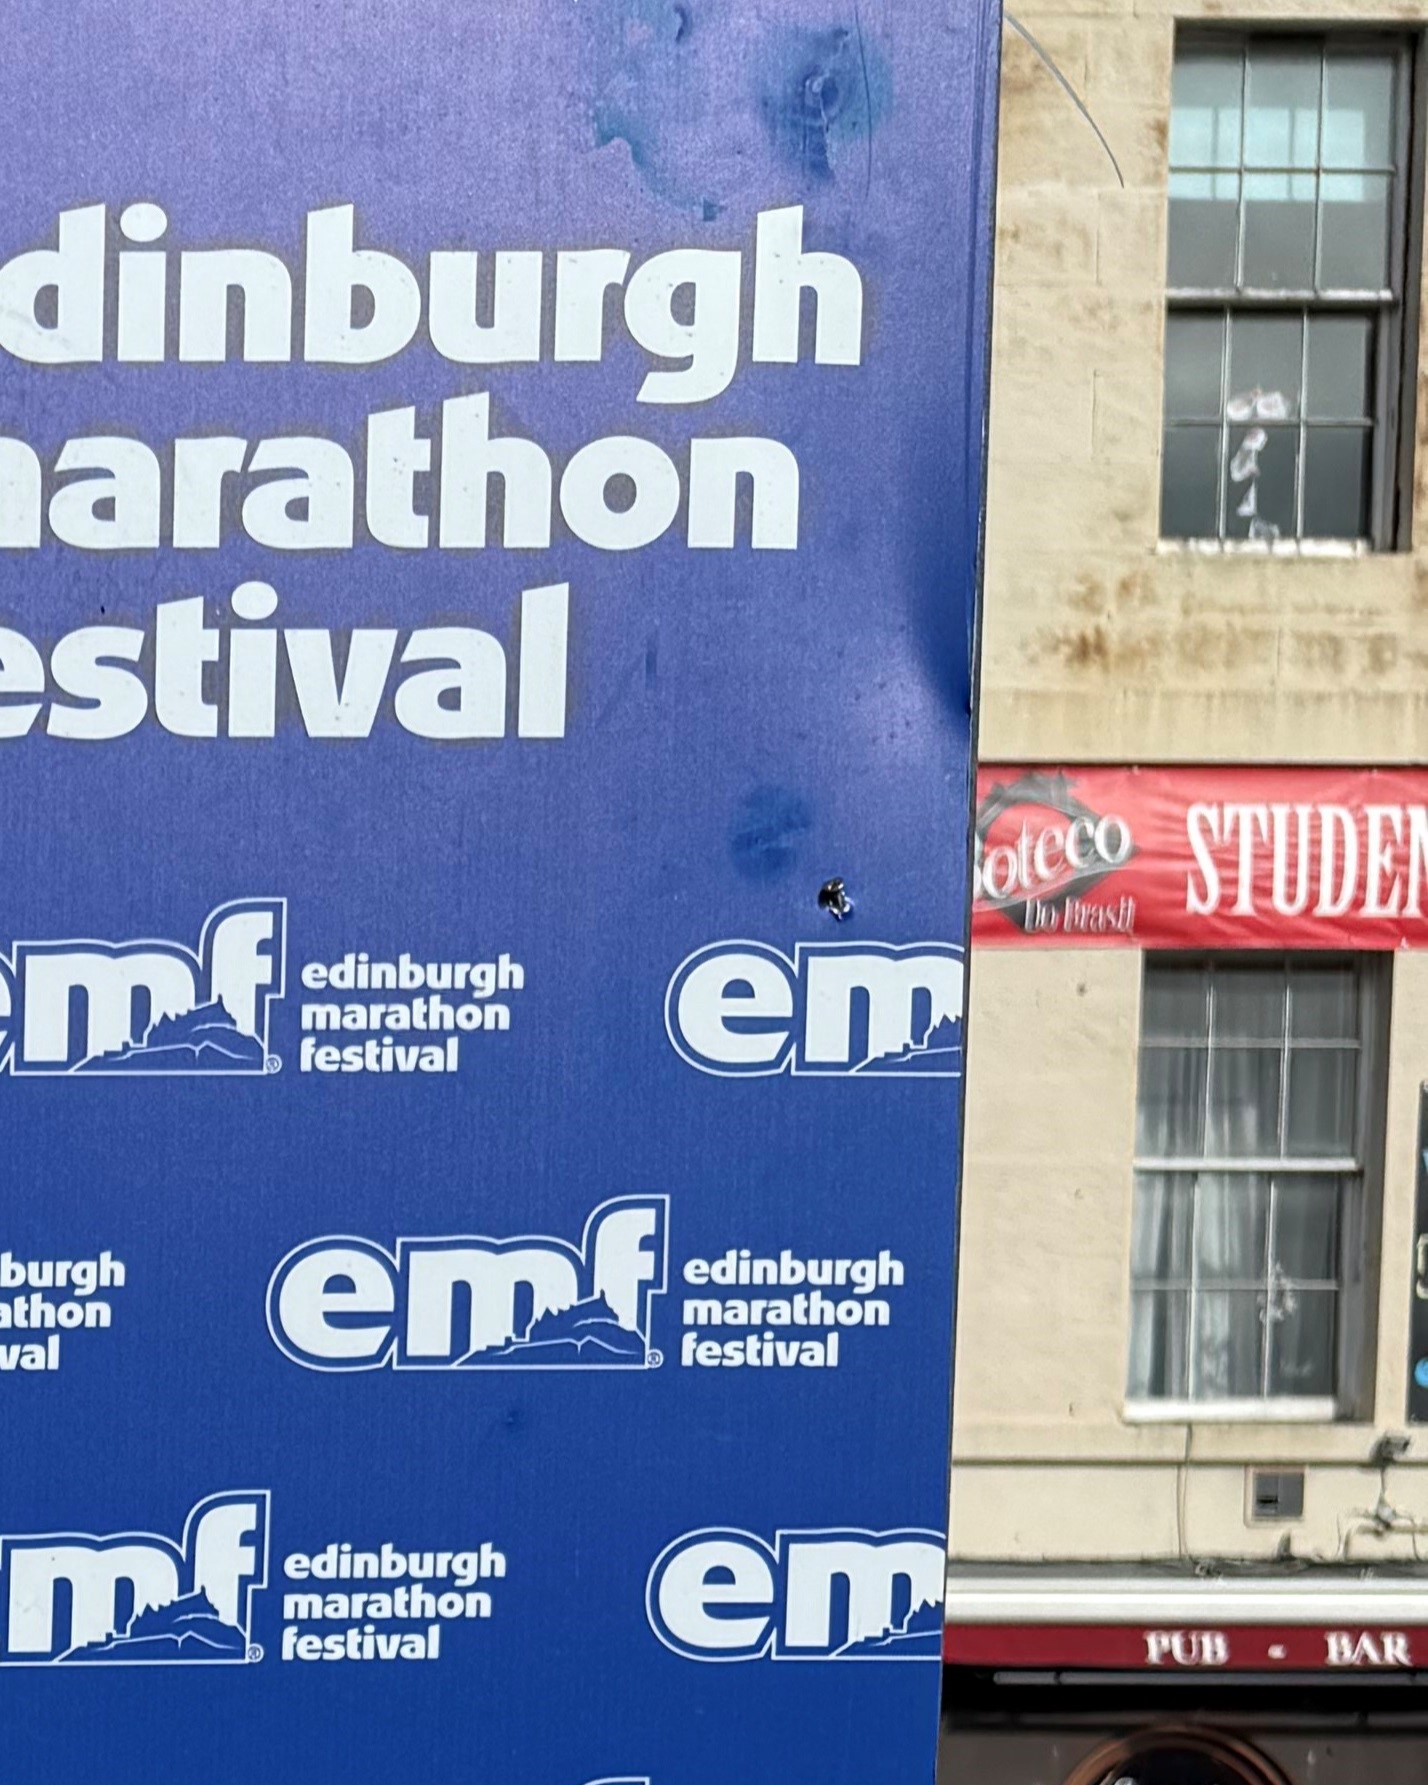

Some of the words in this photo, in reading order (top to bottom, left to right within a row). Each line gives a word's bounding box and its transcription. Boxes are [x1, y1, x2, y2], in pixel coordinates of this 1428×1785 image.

[301, 952, 525, 999] edinburgh
[301, 994, 511, 1031] marathon
[300, 1036, 459, 1073] festival
[273, 1201, 663, 1365] emf
[683, 1249, 905, 1295] edinburgh
[682, 1289, 890, 1326] marathon
[681, 1331, 839, 1367] festival
[283, 1542, 507, 1587] edinburgh
[283, 1582, 492, 1620] marathon
[281, 1623, 441, 1661] festival
[1144, 1630, 1230, 1666] PUB
[1325, 1631, 1413, 1667] BAR
